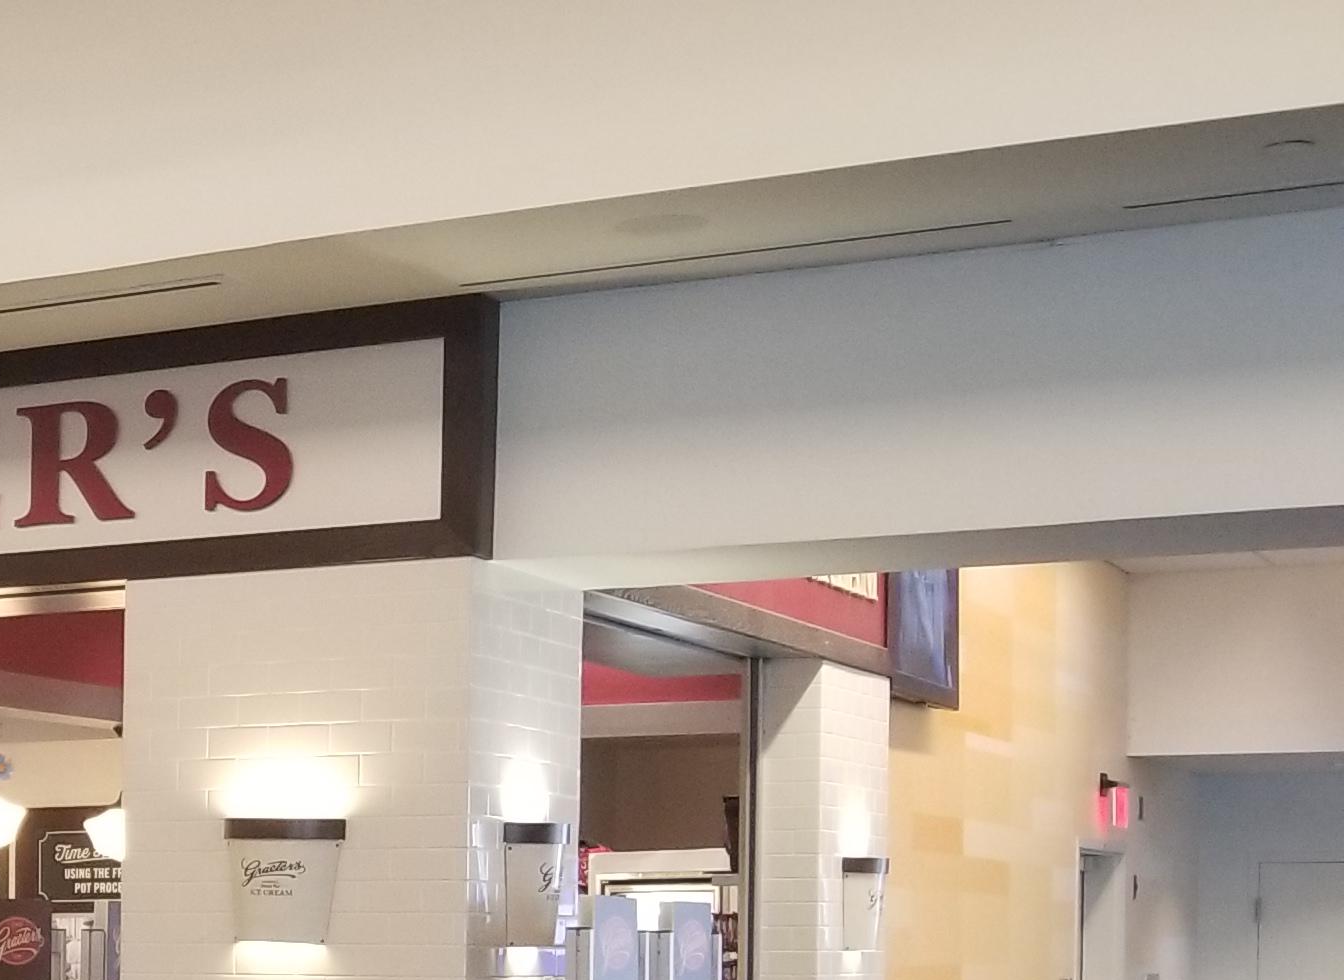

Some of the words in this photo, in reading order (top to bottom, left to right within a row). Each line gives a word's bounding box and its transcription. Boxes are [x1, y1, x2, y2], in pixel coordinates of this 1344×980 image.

[64, 867, 92, 880] USING
[93, 867, 111, 879] THE
[74, 882, 92, 894] POT
